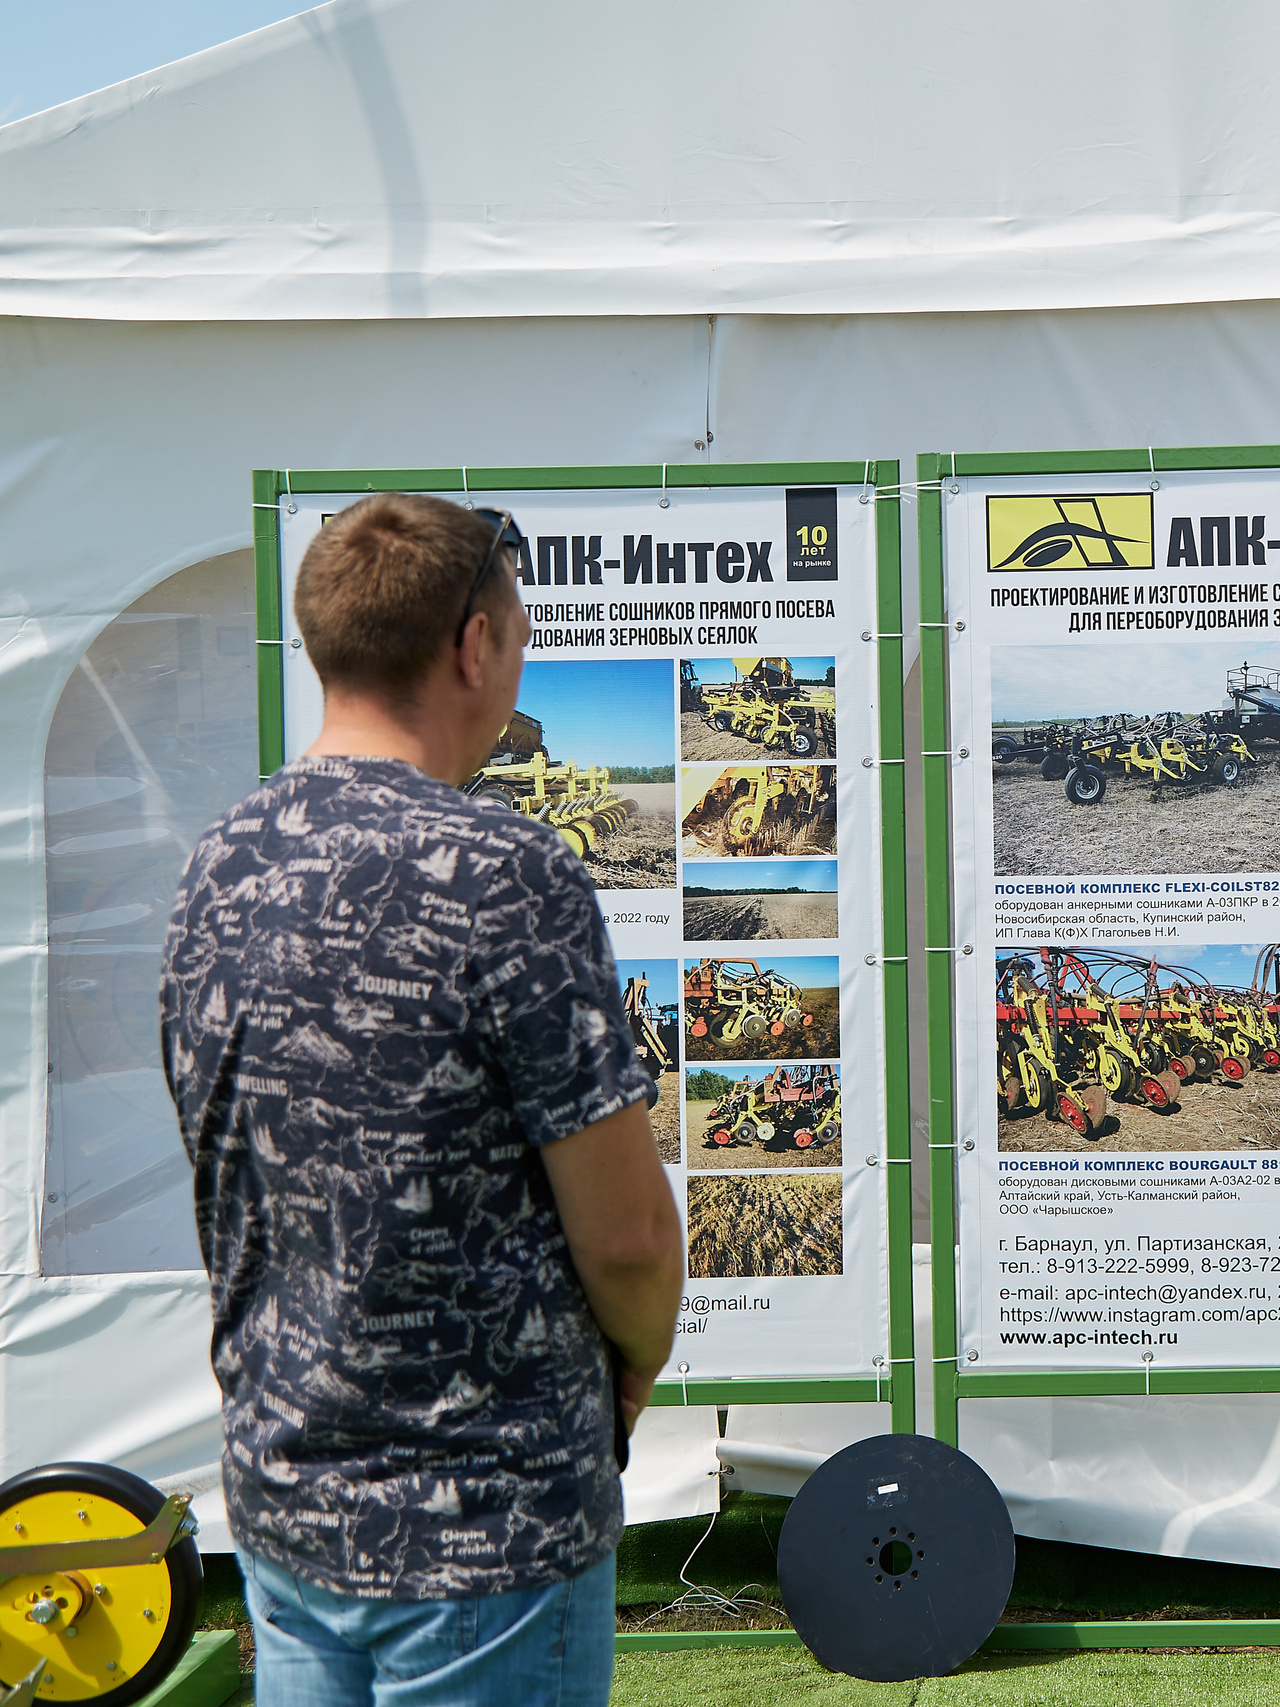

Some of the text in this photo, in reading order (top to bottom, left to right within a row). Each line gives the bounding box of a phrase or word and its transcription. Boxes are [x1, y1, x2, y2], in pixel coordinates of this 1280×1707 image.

[796, 525, 828, 546] 10
[516, 534, 775, 586] АПК-Интех
[800, 545, 826, 557] лет
[805, 559, 832, 569] рынке
[990, 586, 1130, 607] ПРОЕКТИРОВАНИЕ
[1134, 585, 1144, 605] И
[1148, 583, 1269, 605] ИЗГОТОВЛЕНИЕ
[524, 599, 836, 623] ТОВЛЕНИЕ СОШНИКОВ ПРЯМОГО ПОСЕВА
[1068, 611, 1102, 634] ДЛЯ
[1106, 608, 1269, 631] ПЕРЕОБОРУДОВАНИЯ
[531, 625, 758, 650] ДОВАНИЯ ЗЕРНОВЫХ СЕЯЛОК
[286, 858, 334, 873] CAMPING
[994, 881, 1076, 895] ПОСЕВНОЙ
[1080, 882, 1161, 894] КОМПЛЕКС
[994, 899, 1064, 913] оборудован
[1067, 901, 1133, 912] анкерными
[1136, 900, 1203, 909] сошниками
[1262, 899, 1269, 907] в
[603, 912, 670, 925] в 2022 году
[995, 911, 1246, 927] Новосибирская область, Купинский район,
[995, 926, 1180, 941] ИП Глава К(Ф)Х Глагольев Н.И.
[354, 975, 433, 1001] JOURNEY
[998, 1158, 1080, 1171] ПОСЕВНОЙ
[1084, 1160, 1165, 1171] КОМПЛЕКС
[1169, 1159, 1258, 1171] BOURGAULT
[998, 1176, 1068, 1190] оборудован
[1070, 1178, 1136, 1189] дисковыми
[1139, 1178, 1206, 1187] сошниками
[1274, 1177, 1280, 1185] в
[998, 1189, 1241, 1203] Алтайский край, Усть-Калманский район,
[999, 1203, 1114, 1218] ООО «Чарышское»
[999, 1239, 1008, 1252] г.
[1015, 1235, 1098, 1256] Барнаул,
[1104, 1239, 1131, 1256] ул.
[1137, 1235, 1272, 1255] Партизанская,
[998, 1261, 1040, 1274] тел.:
[1047, 1257, 1194, 1276] 8-913-222-5999,
[999, 1284, 1059, 1301] e-mail:
[1065, 1284, 1271, 1305] apc-intech@yandex.ru,
[680, 1294, 770, 1316] 9@mail.ru
[358, 1309, 436, 1335] JOURNEY
[674, 1317, 708, 1334] cial/
[999, 1329, 1178, 1349] www.apc-intech.ru
[263, 1391, 305, 1429] TRAVELLING
[296, 1508, 339, 1529] CAMPING
[440, 1528, 487, 1545] Chirping
